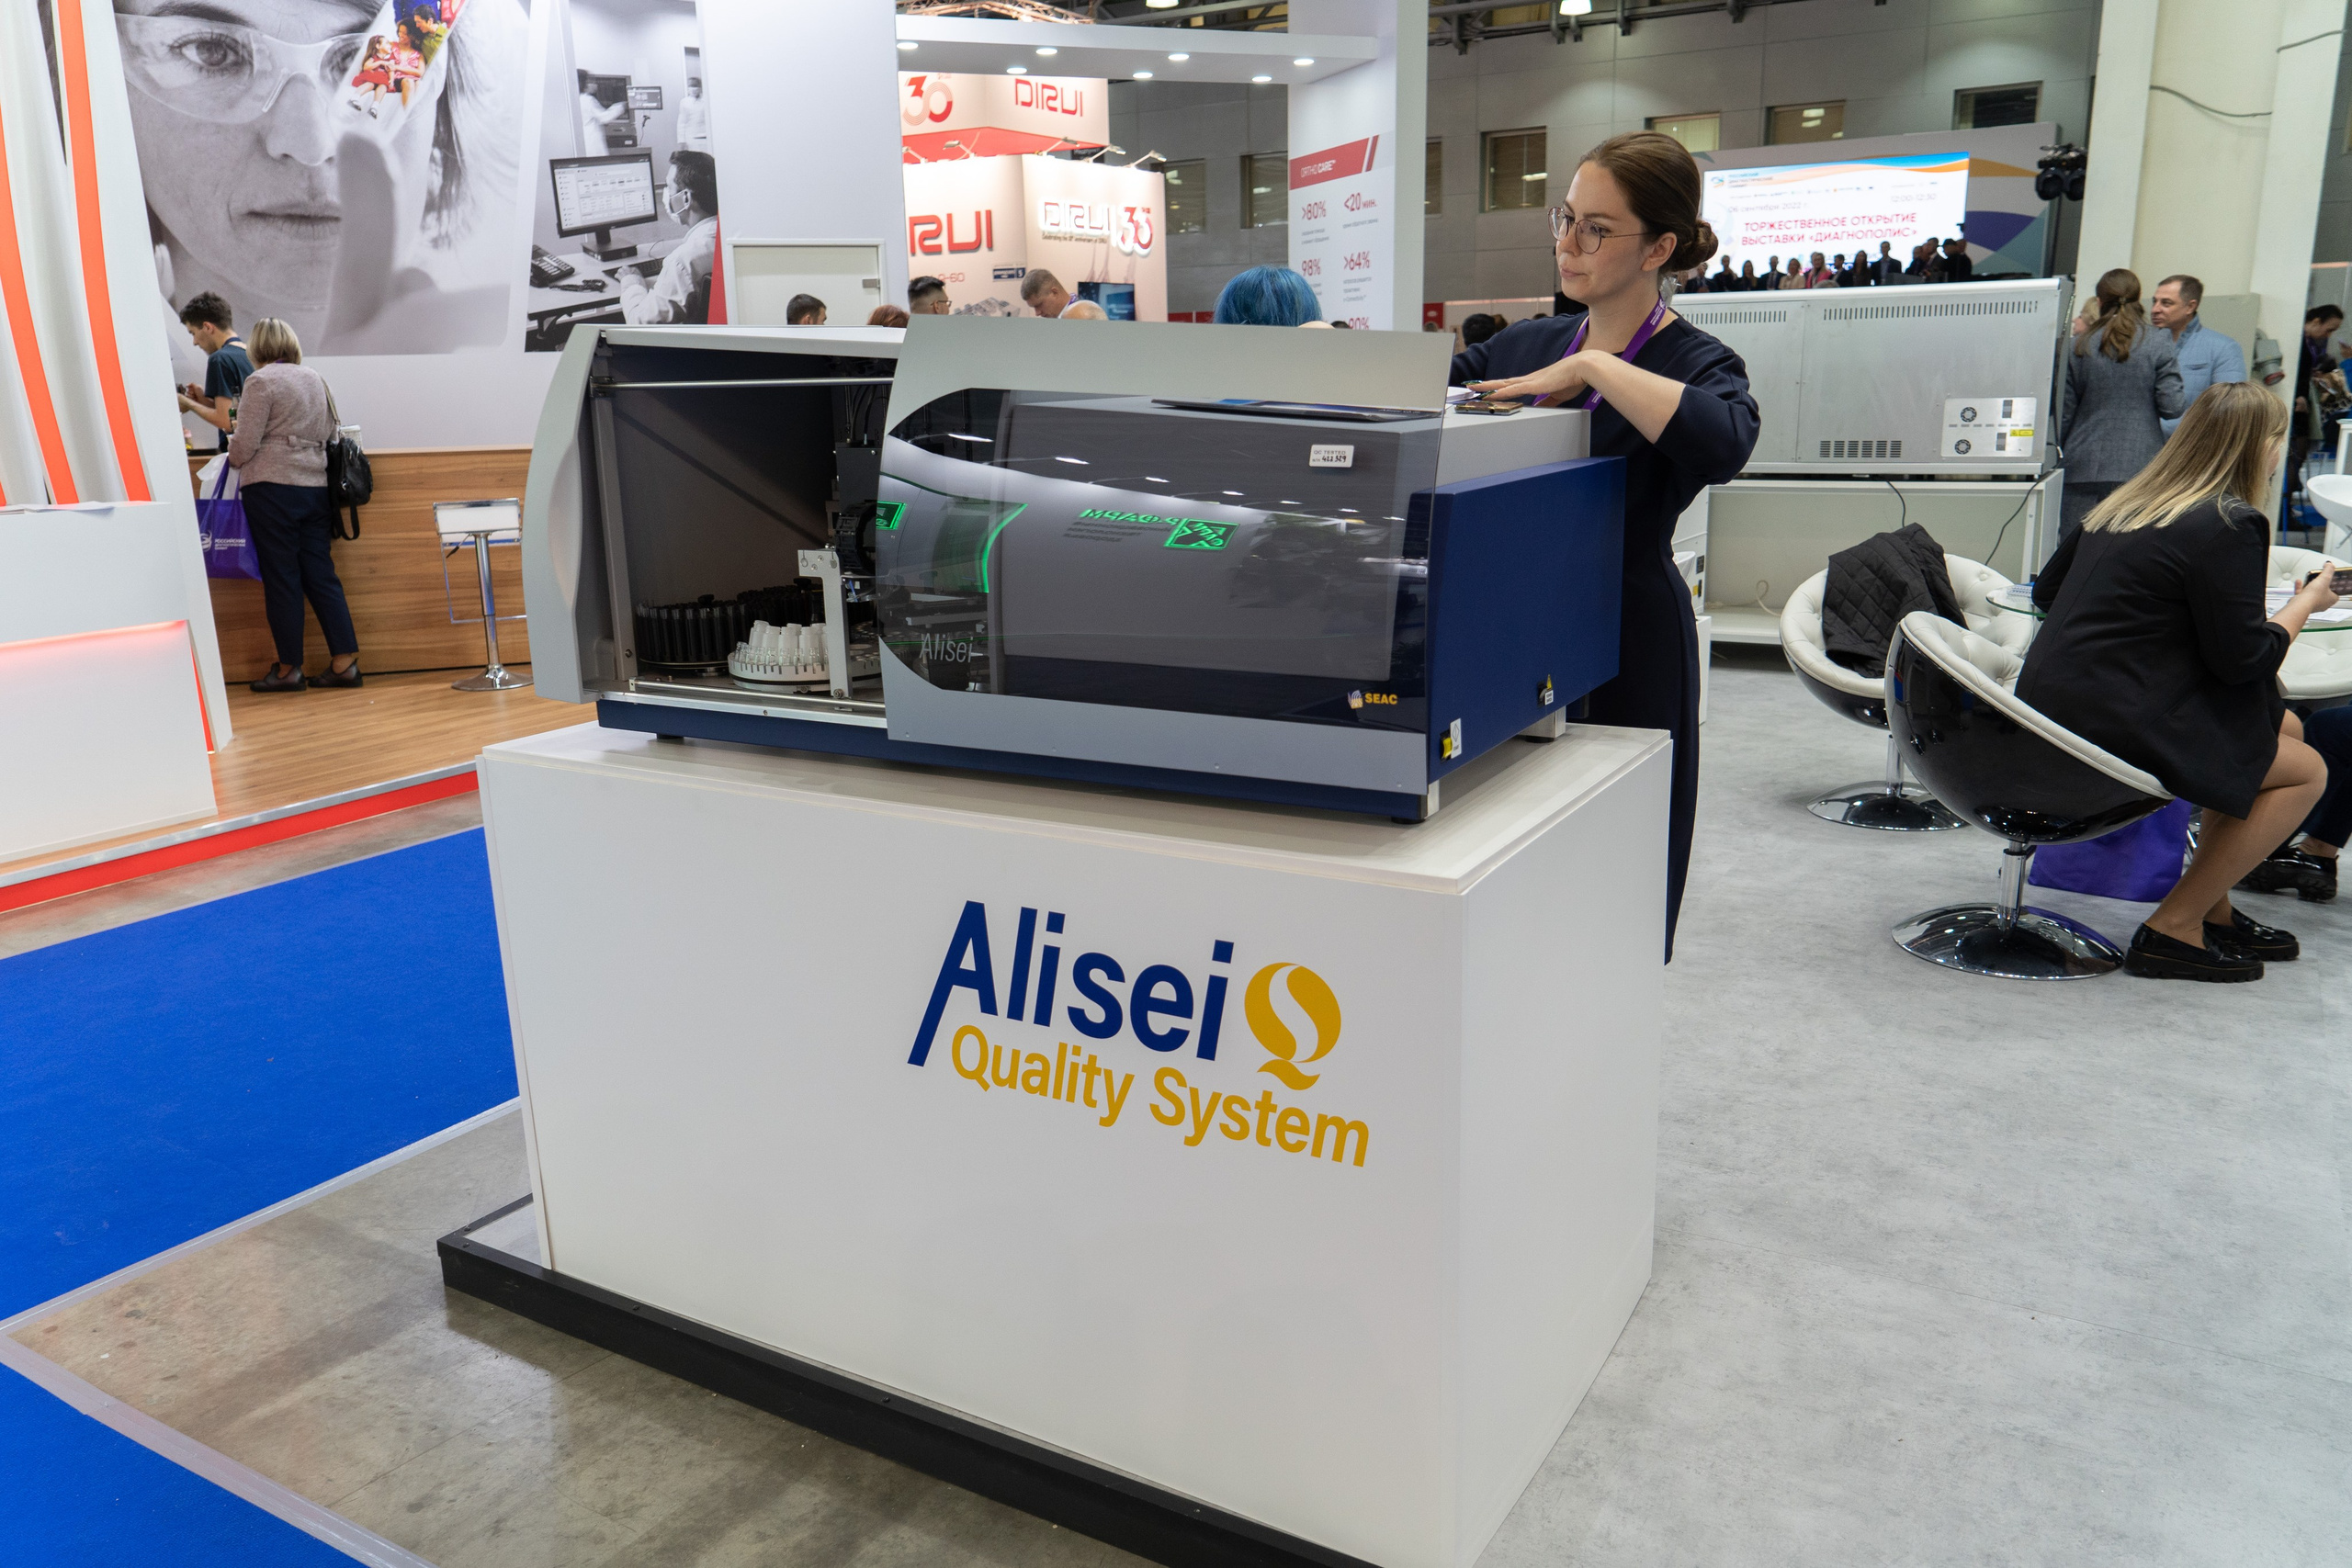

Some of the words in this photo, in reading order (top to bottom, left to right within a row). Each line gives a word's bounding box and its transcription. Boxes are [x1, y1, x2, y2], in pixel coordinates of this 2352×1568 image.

[1015, 78, 1083, 117] DIRUI
[1301, 200, 1327, 220] >80%
[1343, 192, 1362, 212] <20
[1745, 217, 1847, 232] ТОРЖЕСТВЕННОЕ
[1850, 212, 1917, 226] ОТКРЫТИЕ
[909, 209, 994, 256] RUI
[1741, 233, 1804, 246] ВЫСТАВКИ
[1810, 227, 1917, 243] «ДИАГНОПОЛИС»
[1301, 258, 1322, 276] 98%
[1343, 251, 1371, 270] >64%
[1347, 317, 1371, 330] 90%
[919, 632, 974, 663] Alisei
[1364, 693, 1398, 705] SEAC
[906, 899, 1235, 1067] Alisei
[951, 1024, 1135, 1128] Quality
[1148, 1066, 1370, 1168] System
